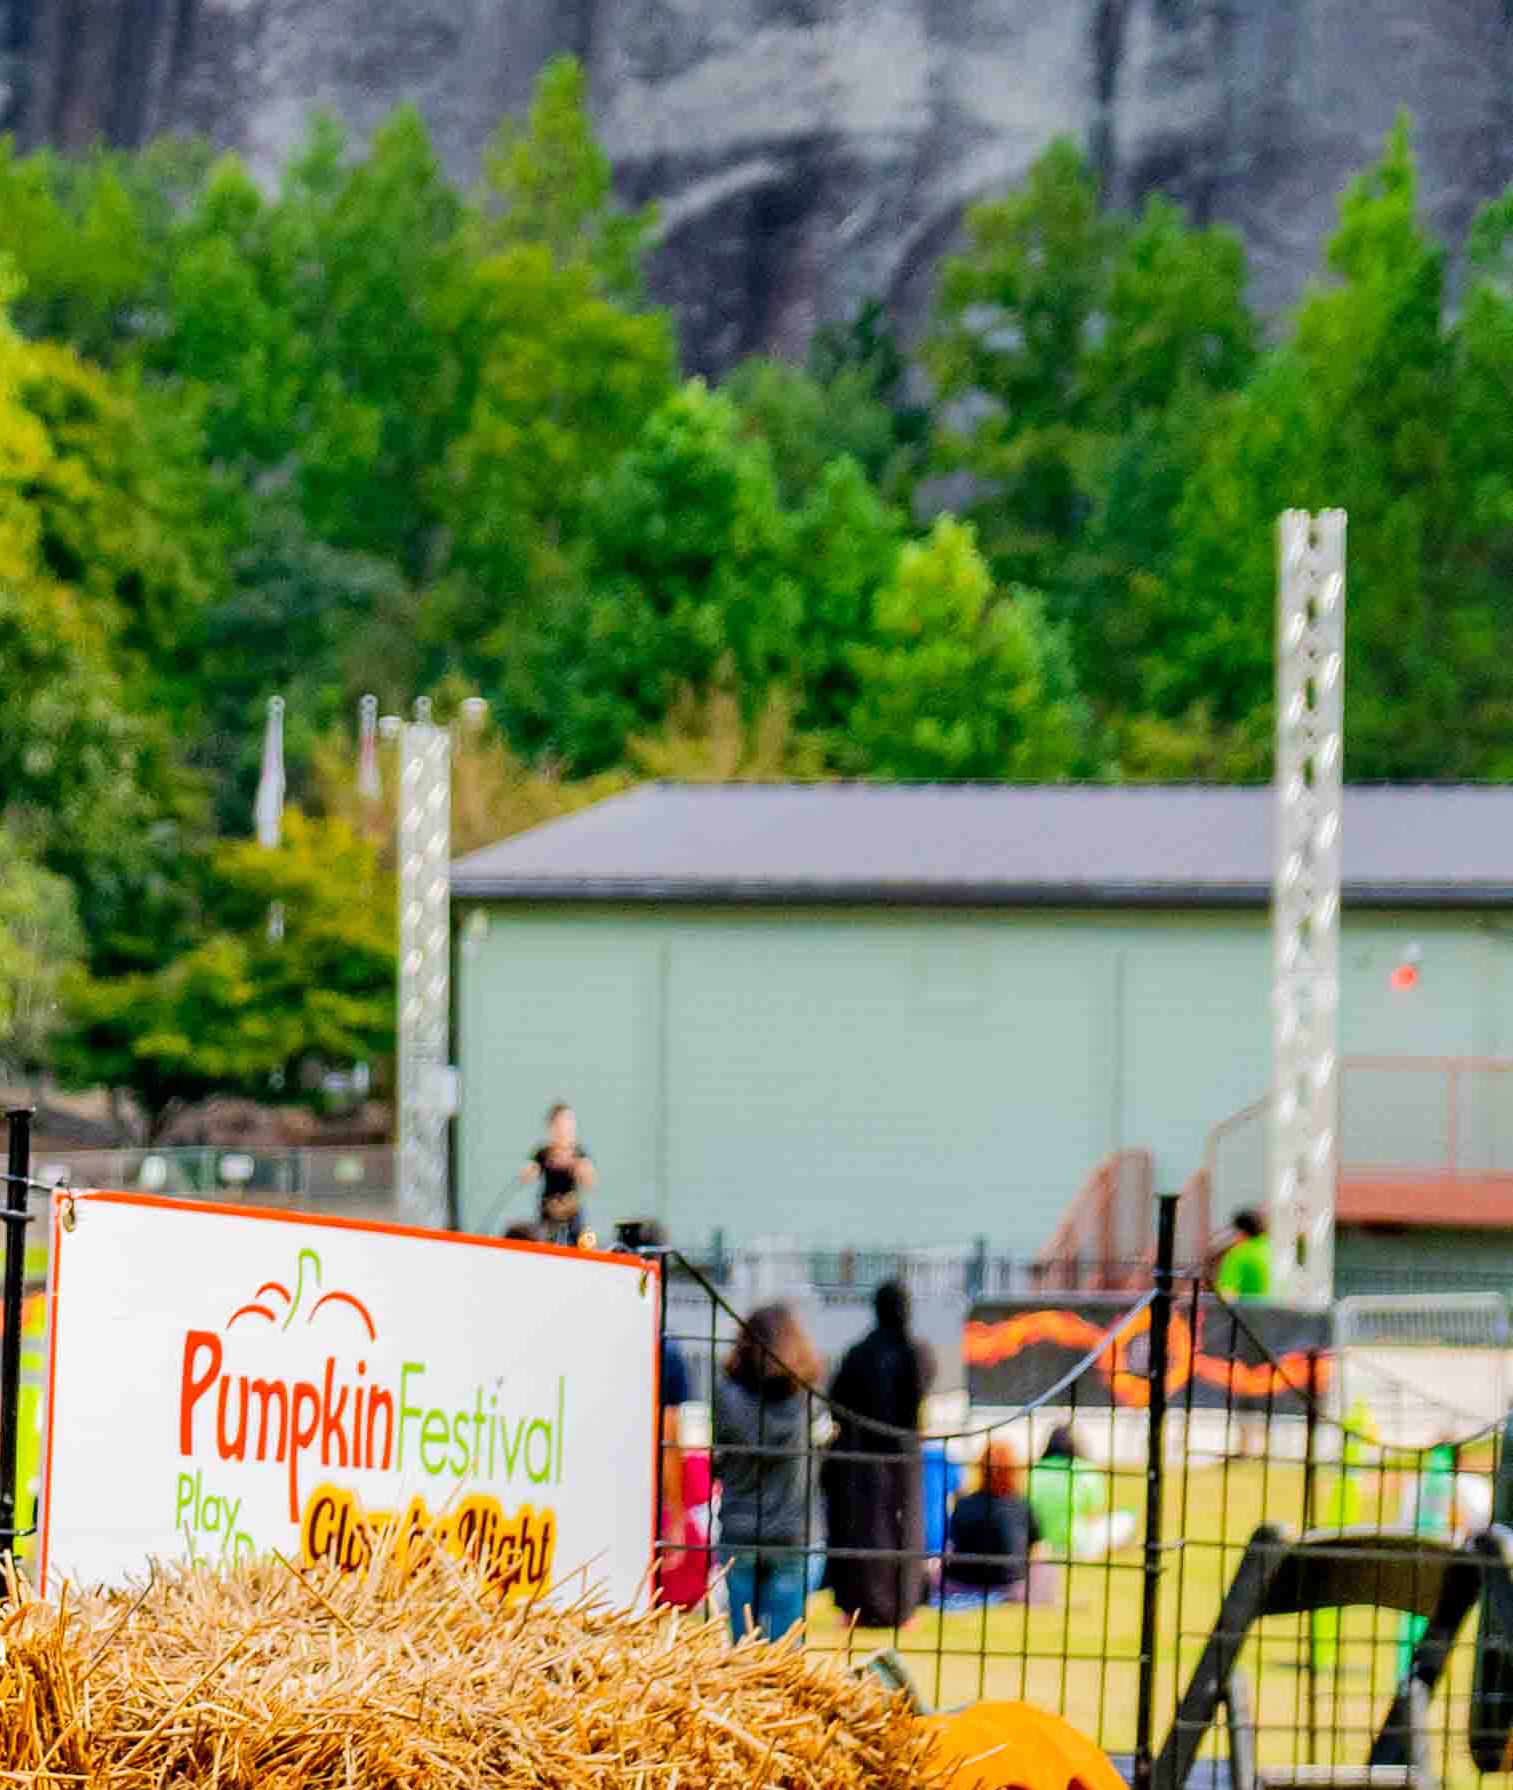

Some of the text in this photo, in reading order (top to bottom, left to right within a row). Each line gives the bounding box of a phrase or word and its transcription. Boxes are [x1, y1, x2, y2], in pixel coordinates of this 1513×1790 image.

[178, 1330, 565, 1524] Pumpkin Festival
[175, 1470, 241, 1553] Play
